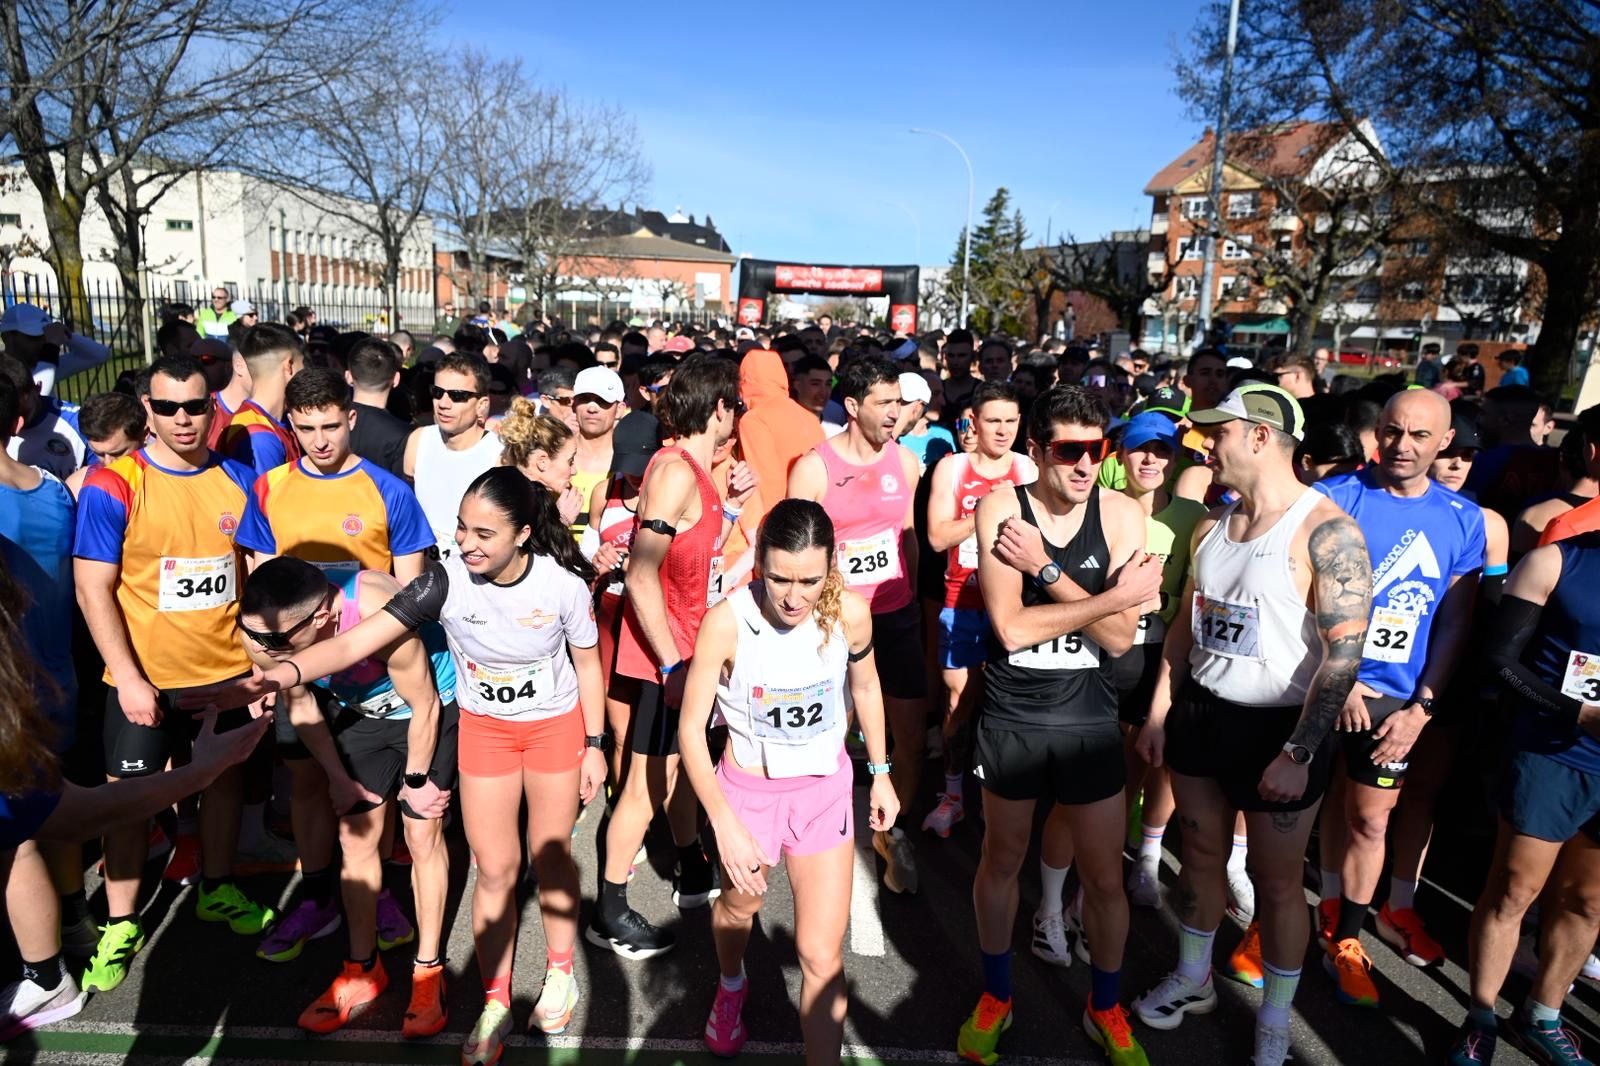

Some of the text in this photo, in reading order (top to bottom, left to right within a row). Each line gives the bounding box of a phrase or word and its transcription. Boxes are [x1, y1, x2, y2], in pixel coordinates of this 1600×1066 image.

[848, 550, 889, 575] 238
[176, 573, 227, 598] 340
[1202, 616, 1245, 643] 127
[1373, 628, 1409, 650] 32
[479, 679, 537, 704] 304
[1581, 678, 1600, 702] 3
[766, 702, 823, 729] 132
